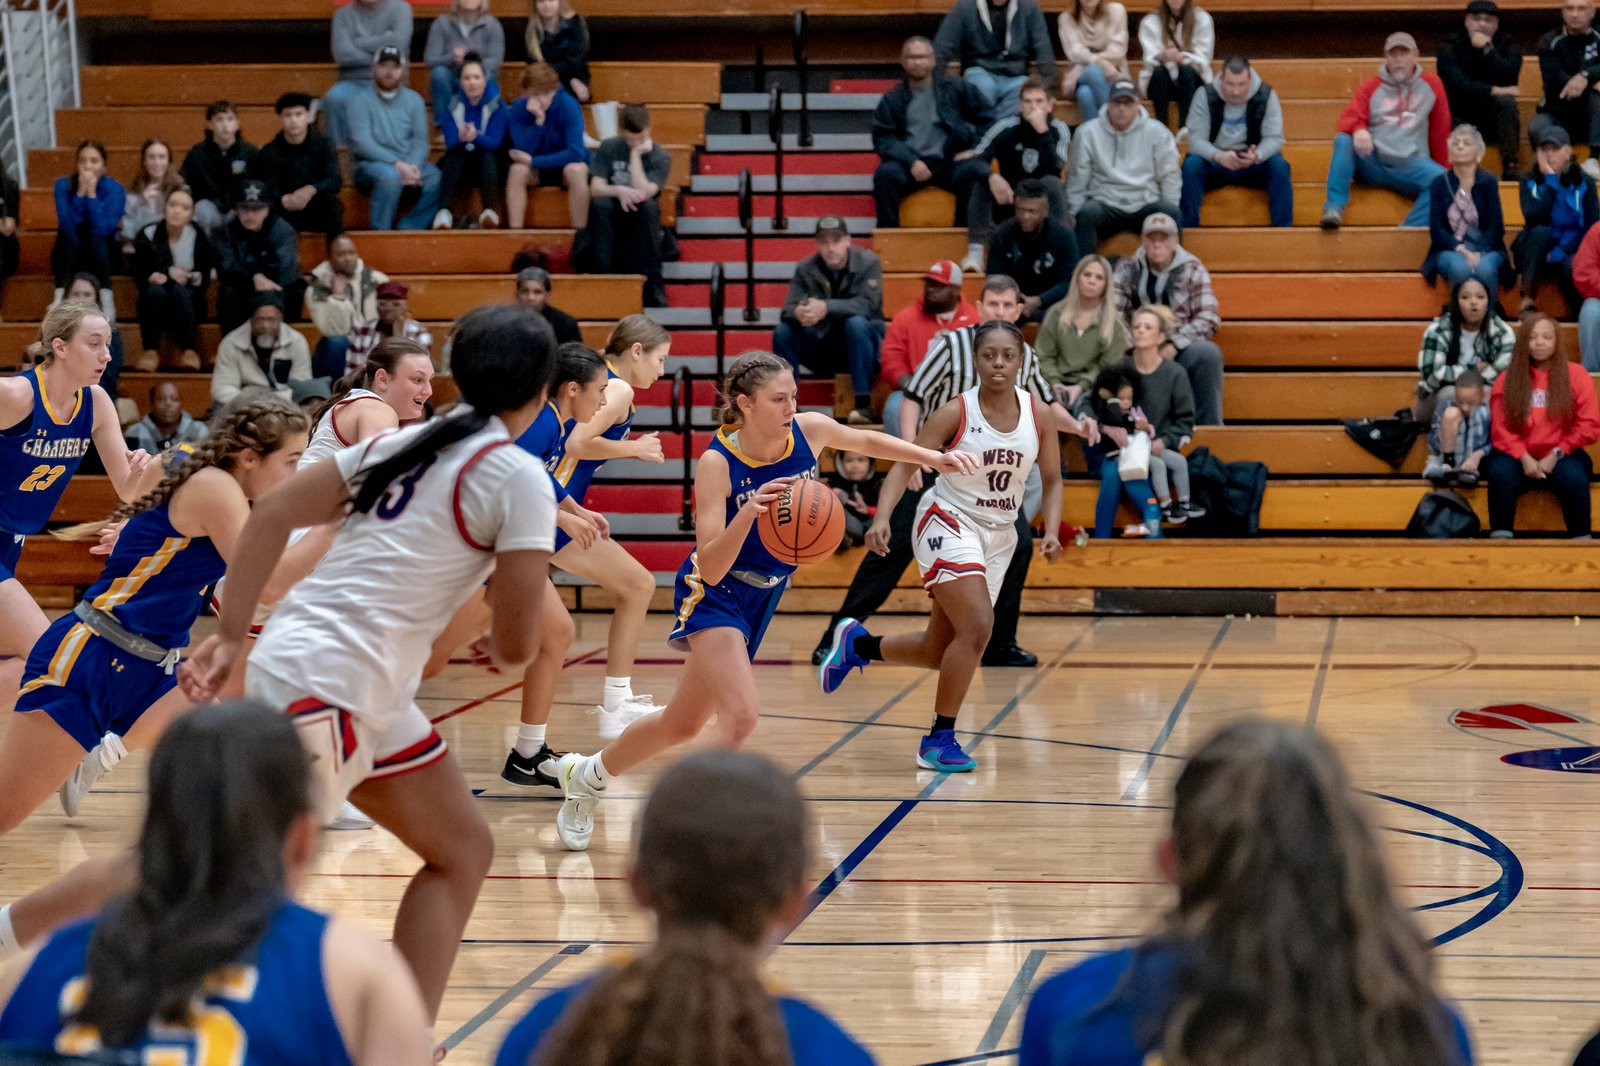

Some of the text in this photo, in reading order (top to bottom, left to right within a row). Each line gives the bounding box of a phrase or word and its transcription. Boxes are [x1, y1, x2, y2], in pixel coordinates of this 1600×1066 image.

[983, 448, 1024, 468] WEST
[19, 465, 66, 492] 23
[986, 470, 1012, 492] 10
[777, 481, 795, 527] Wils
